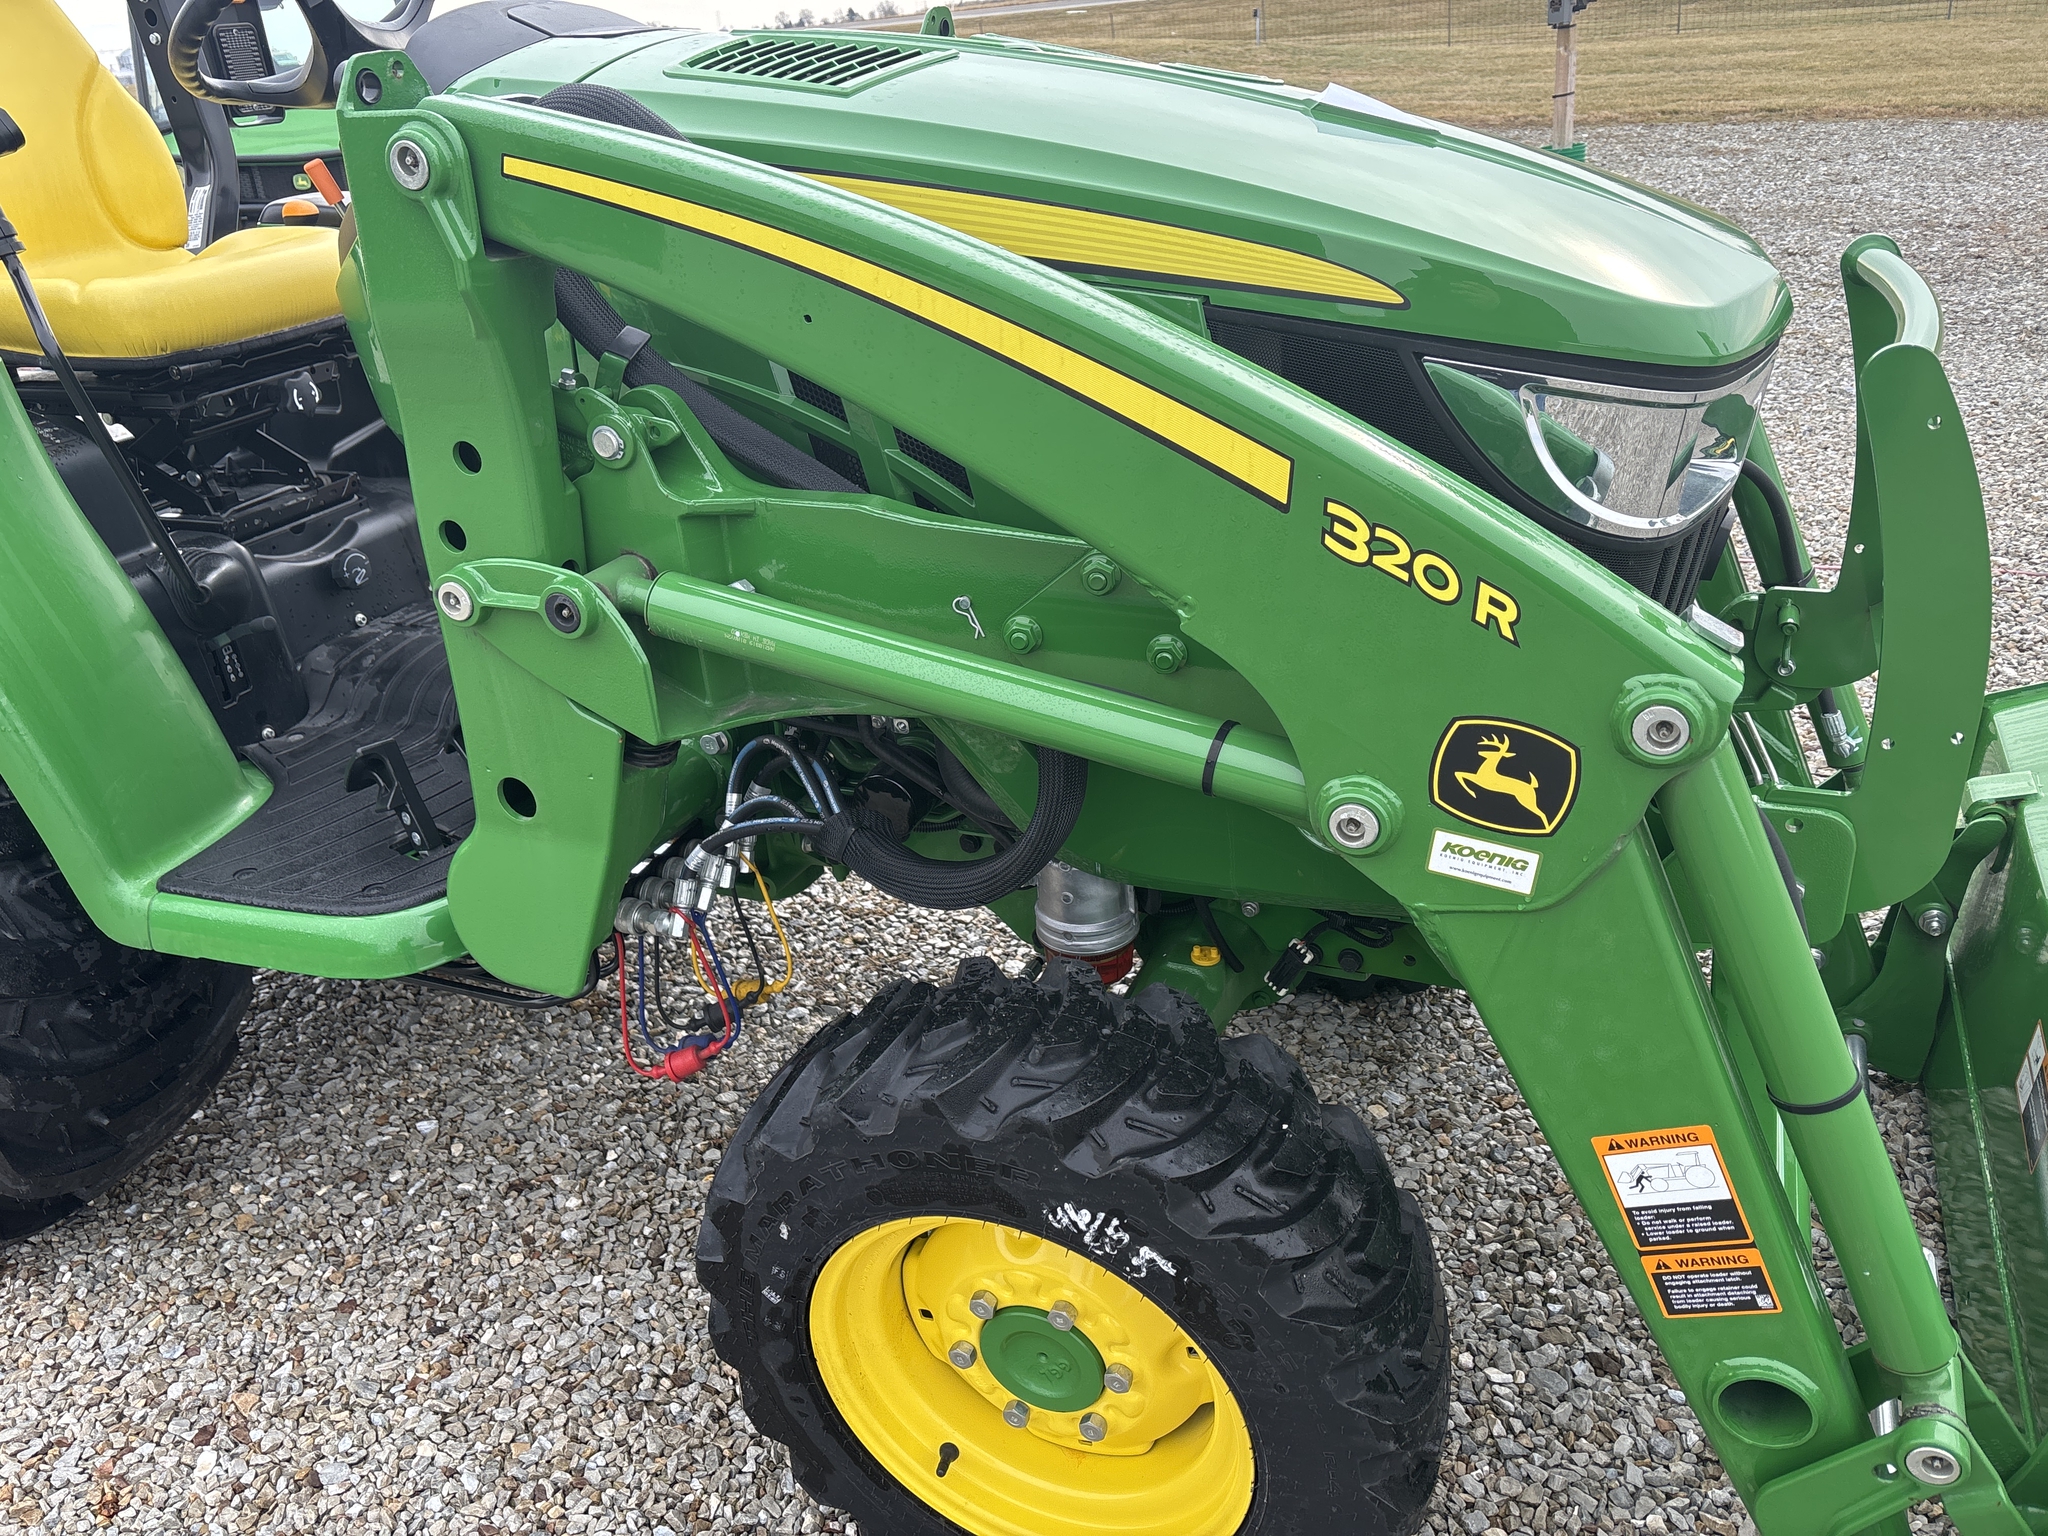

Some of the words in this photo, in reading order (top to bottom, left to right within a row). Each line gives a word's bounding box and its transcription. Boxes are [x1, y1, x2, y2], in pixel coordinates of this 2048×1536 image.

[1322, 498, 1462, 604] 320
[1472, 578, 1520, 646] R
[1440, 853, 1464, 862] KOENIG
[1624, 1132, 1699, 1148] WARNING
[743, 1150, 1044, 1265] MARATHONER
[1675, 1254, 1749, 1268] WARNING
[737, 1267, 760, 1347] THE
